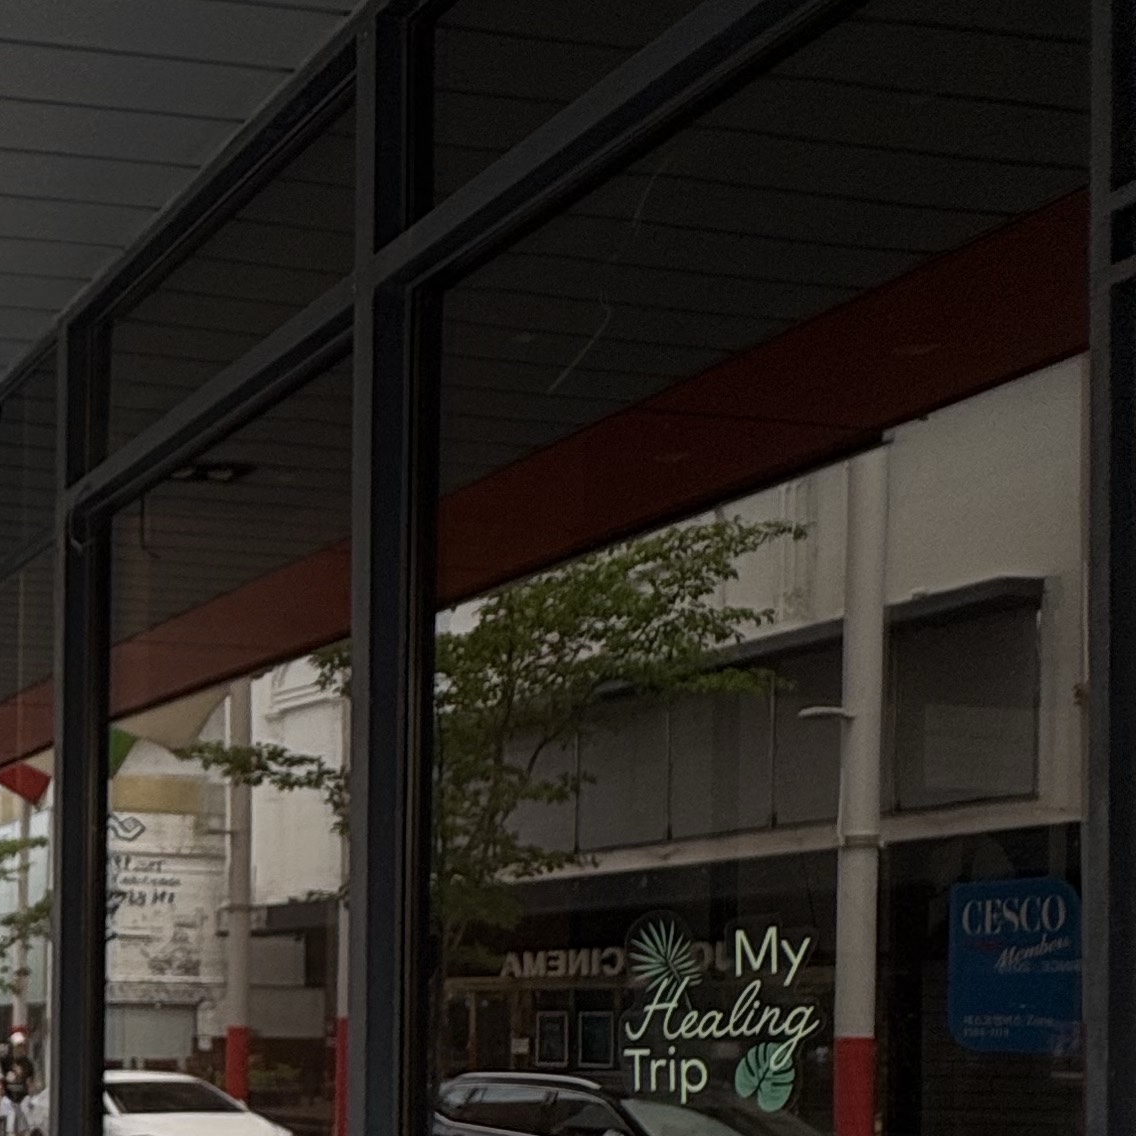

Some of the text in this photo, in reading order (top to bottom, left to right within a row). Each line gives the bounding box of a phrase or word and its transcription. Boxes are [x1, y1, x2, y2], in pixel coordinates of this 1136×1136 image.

[962, 894, 1067, 935] CESCO
[734, 925, 812, 987] My
[624, 975, 820, 1071] Healing
[623, 1046, 709, 1105] Trip
